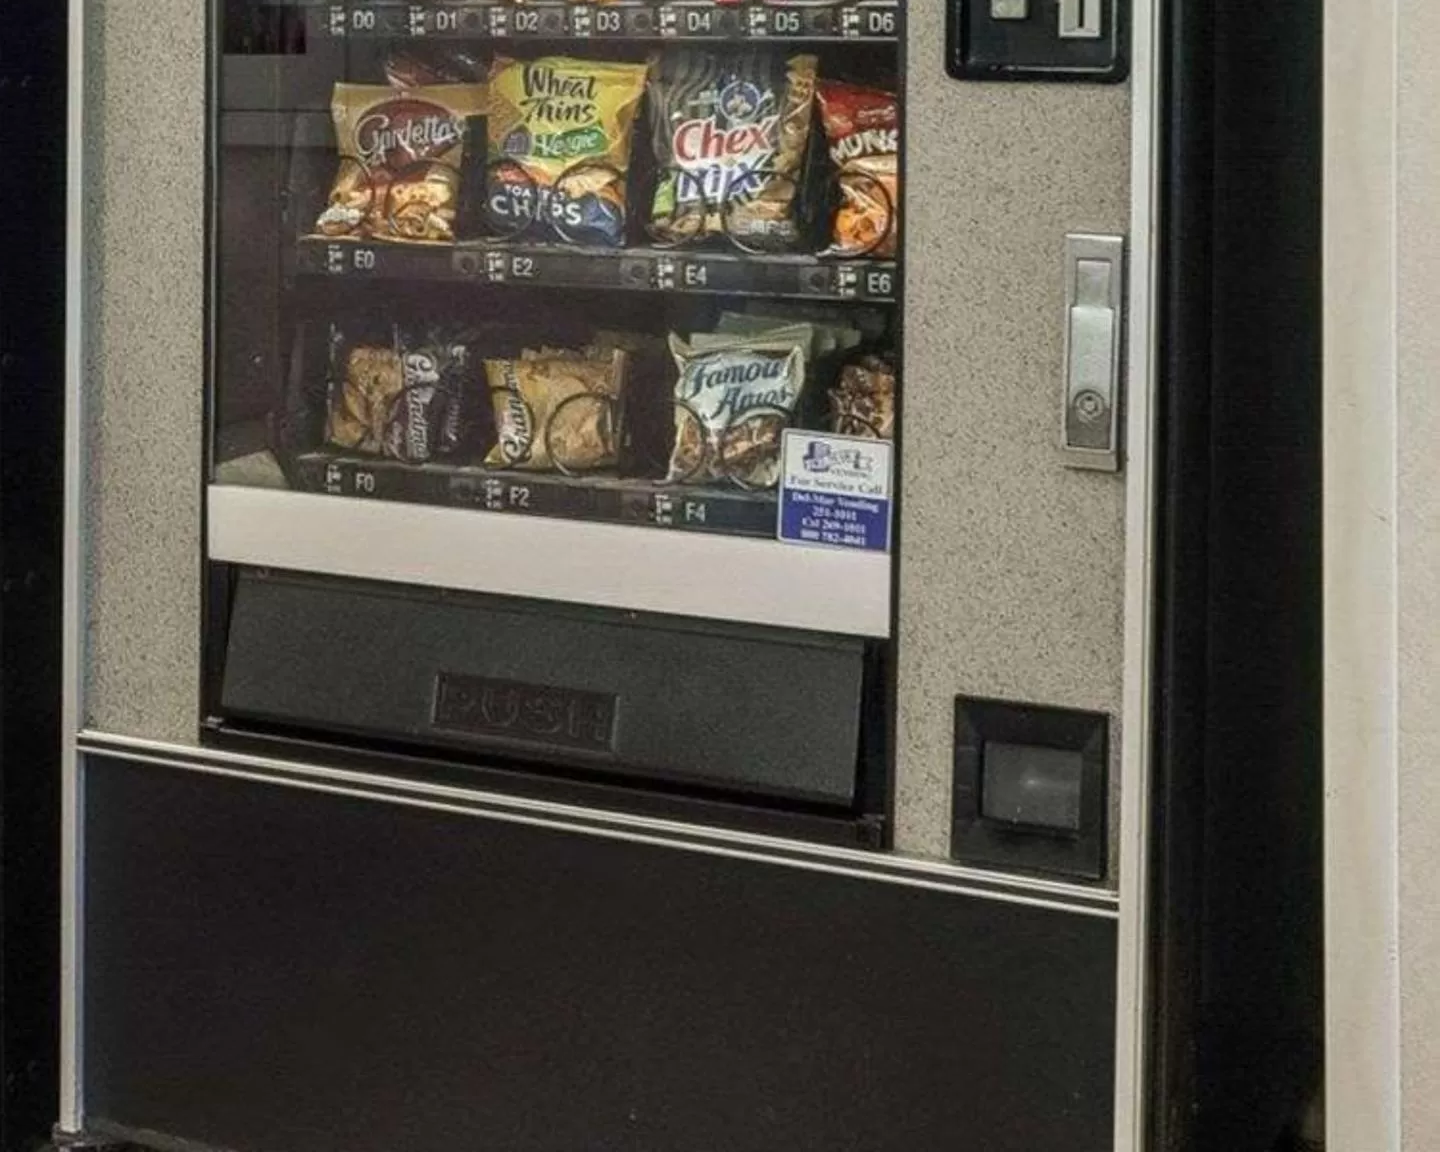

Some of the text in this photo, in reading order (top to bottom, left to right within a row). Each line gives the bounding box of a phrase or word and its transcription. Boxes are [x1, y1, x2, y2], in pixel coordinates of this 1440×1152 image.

[353, 10, 375, 29] D0
[437, 11, 457, 30] D1
[515, 11, 538, 30] D2
[597, 11, 620, 31] D3
[687, 12, 711, 31] D4
[775, 12, 800, 31] D5
[869, 12, 895, 32] D6
[522, 63, 597, 101] Wheat
[521, 101, 596, 126] Thins
[356, 114, 465, 162] Gardetto's
[674, 114, 781, 169] Chex
[677, 156, 772, 204] Mix
[354, 249, 375, 269] E0
[512, 255, 534, 275] E2
[685, 265, 708, 285] E4
[868, 273, 892, 294] E6
[685, 358, 783, 399] Famou
[711, 388, 794, 420] Amos
[355, 473, 375, 493] F0
[815, 478, 855, 491] Service
[859, 484, 882, 494] Call
[510, 486, 530, 508] F2
[685, 502, 706, 523] F4
[439, 680, 609, 742] PUSH
